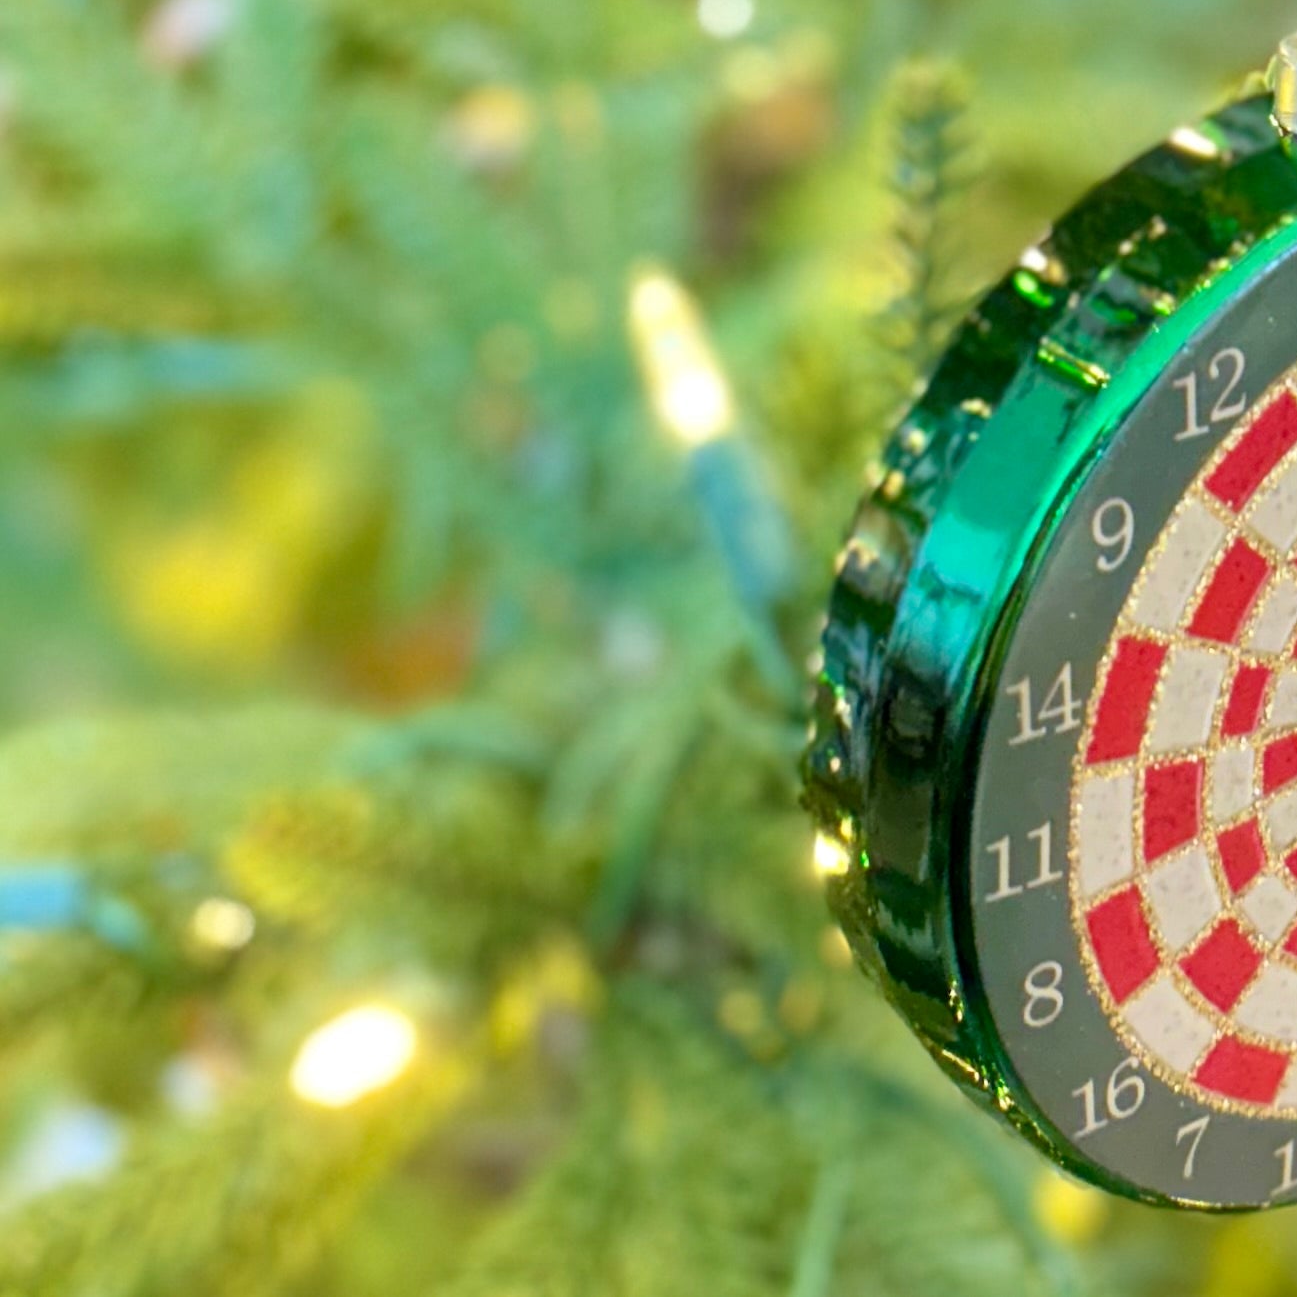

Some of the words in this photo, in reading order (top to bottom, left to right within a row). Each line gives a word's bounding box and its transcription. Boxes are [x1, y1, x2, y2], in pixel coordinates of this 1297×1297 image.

[1173, 347, 1246, 441] 12
[1092, 497, 1134, 571] 9
[1006, 661, 1082, 745] 14
[985, 821, 1063, 902] 11
[1023, 961, 1063, 1028] 8
[1071, 1056, 1145, 1140] 16
[1176, 1115, 1210, 1179] 7
